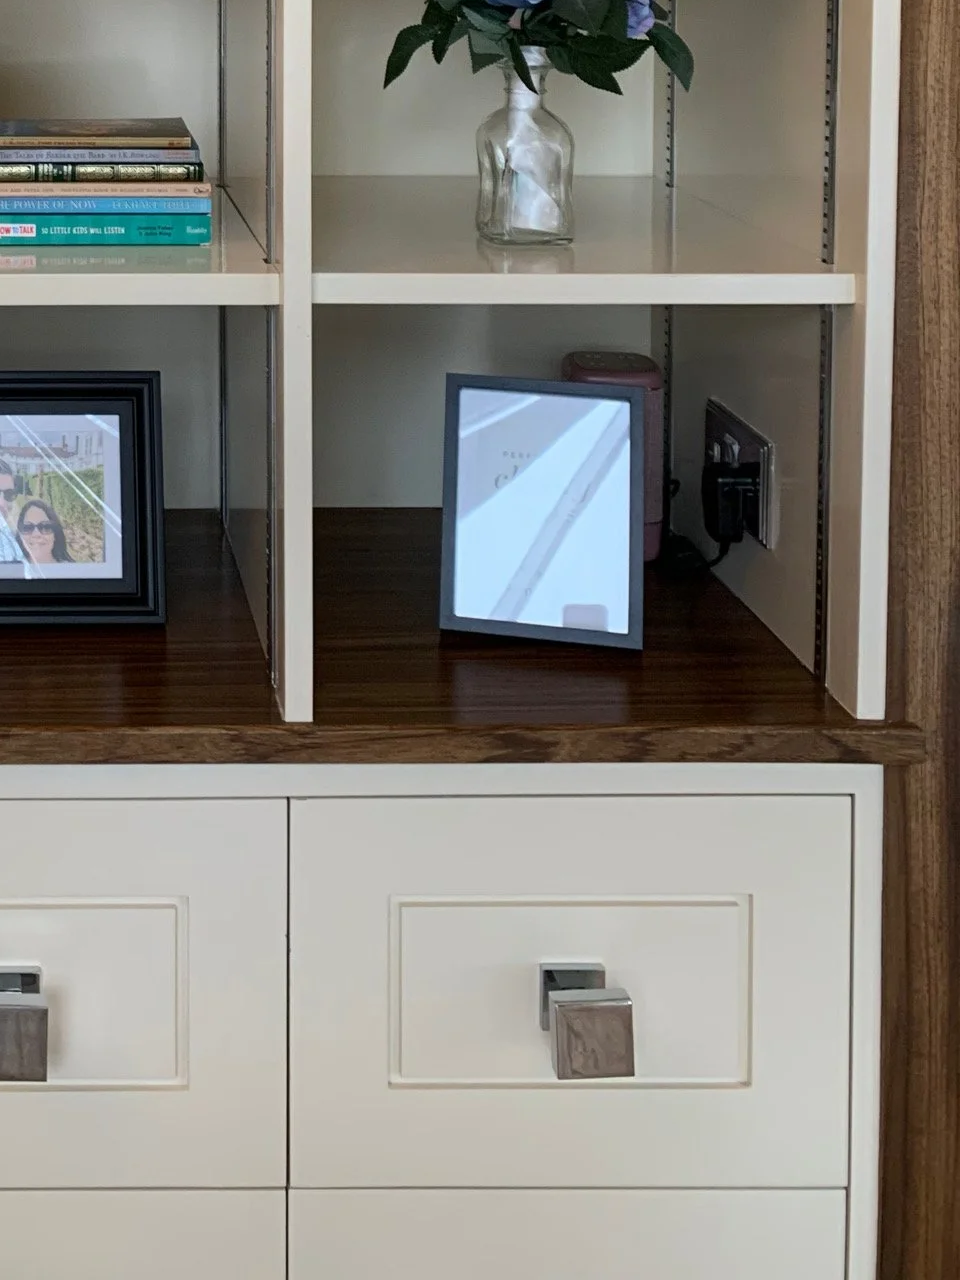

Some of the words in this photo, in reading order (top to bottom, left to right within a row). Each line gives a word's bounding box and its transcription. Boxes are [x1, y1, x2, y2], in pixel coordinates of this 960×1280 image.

[13, 200, 50, 209] POWER
[53, 200, 66, 209] OF
[70, 199, 97, 209] NOW
[19, 225, 35, 234] TALK
[49, 226, 71, 235] LITTLE
[72, 226, 88, 235] KIDS
[104, 226, 126, 235] LISTEN
